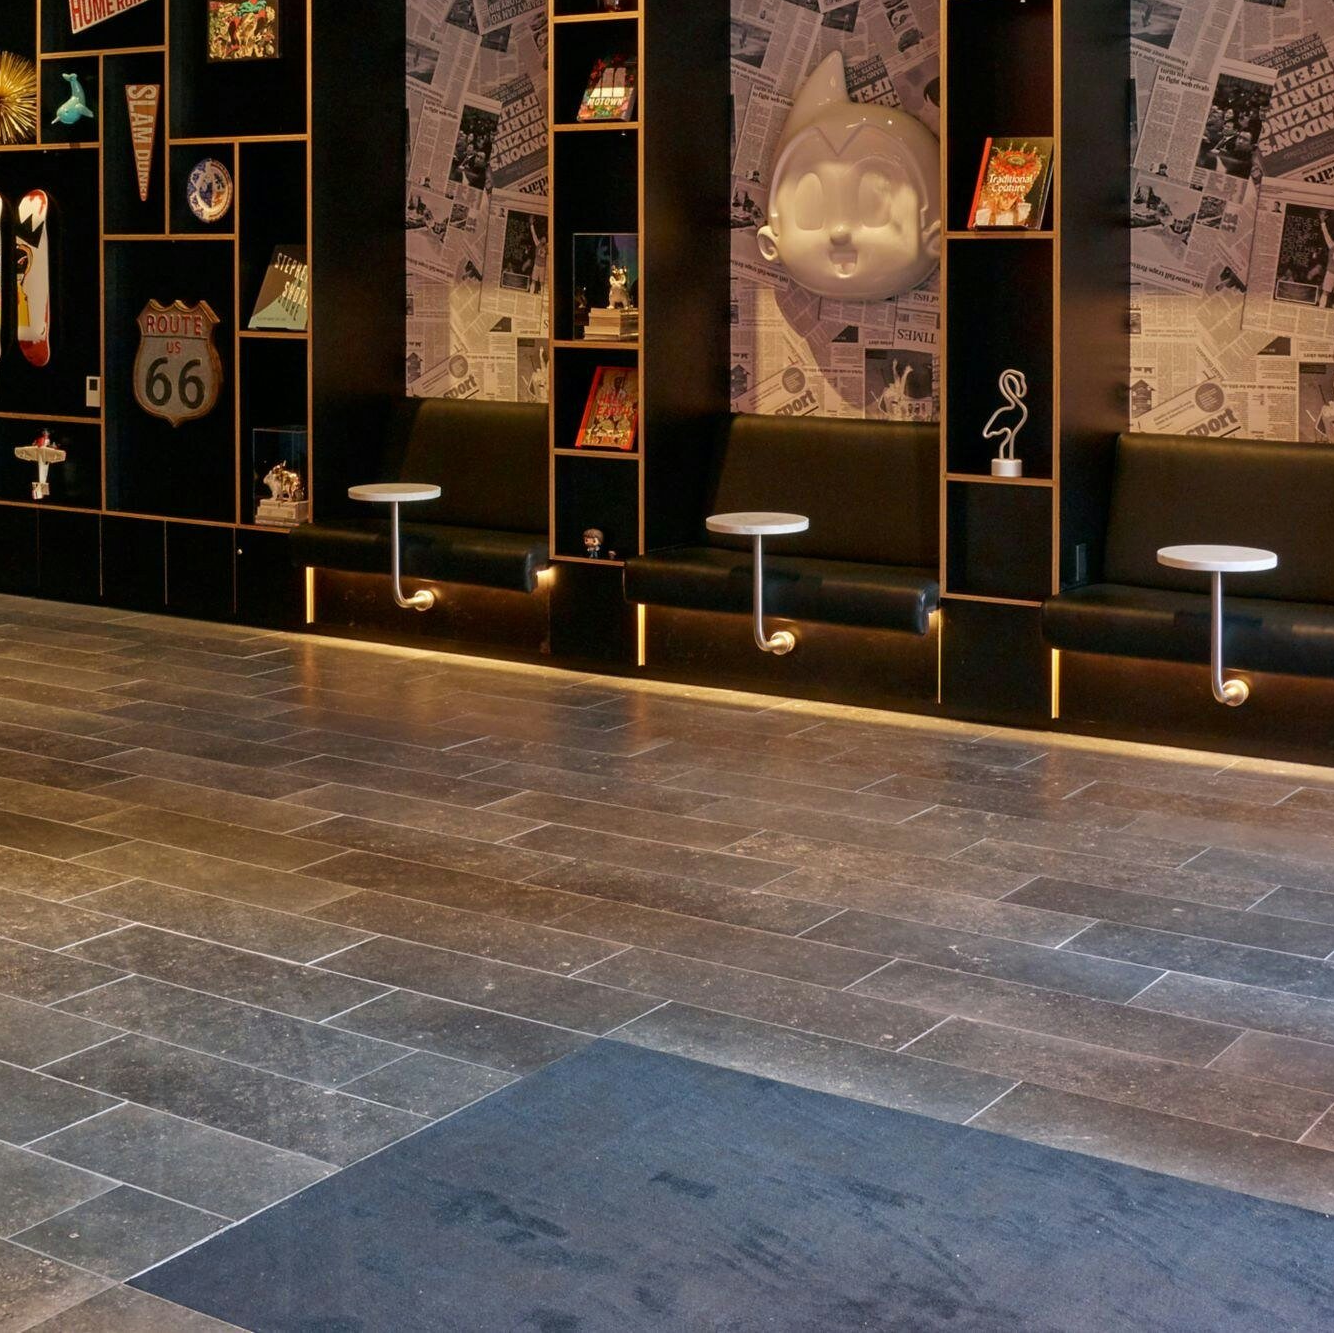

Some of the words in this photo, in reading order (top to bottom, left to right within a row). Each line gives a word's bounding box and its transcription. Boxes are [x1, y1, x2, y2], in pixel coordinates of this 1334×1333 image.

[128, 85, 156, 143] SLAM
[989, 173, 1033, 184] Traditional
[991, 183, 1025, 194] Couture
[147, 313, 203, 336] ROUTE
[896, 328, 938, 345] TIMES
[167, 341, 181, 354] US
[146, 357, 206, 410] 66
